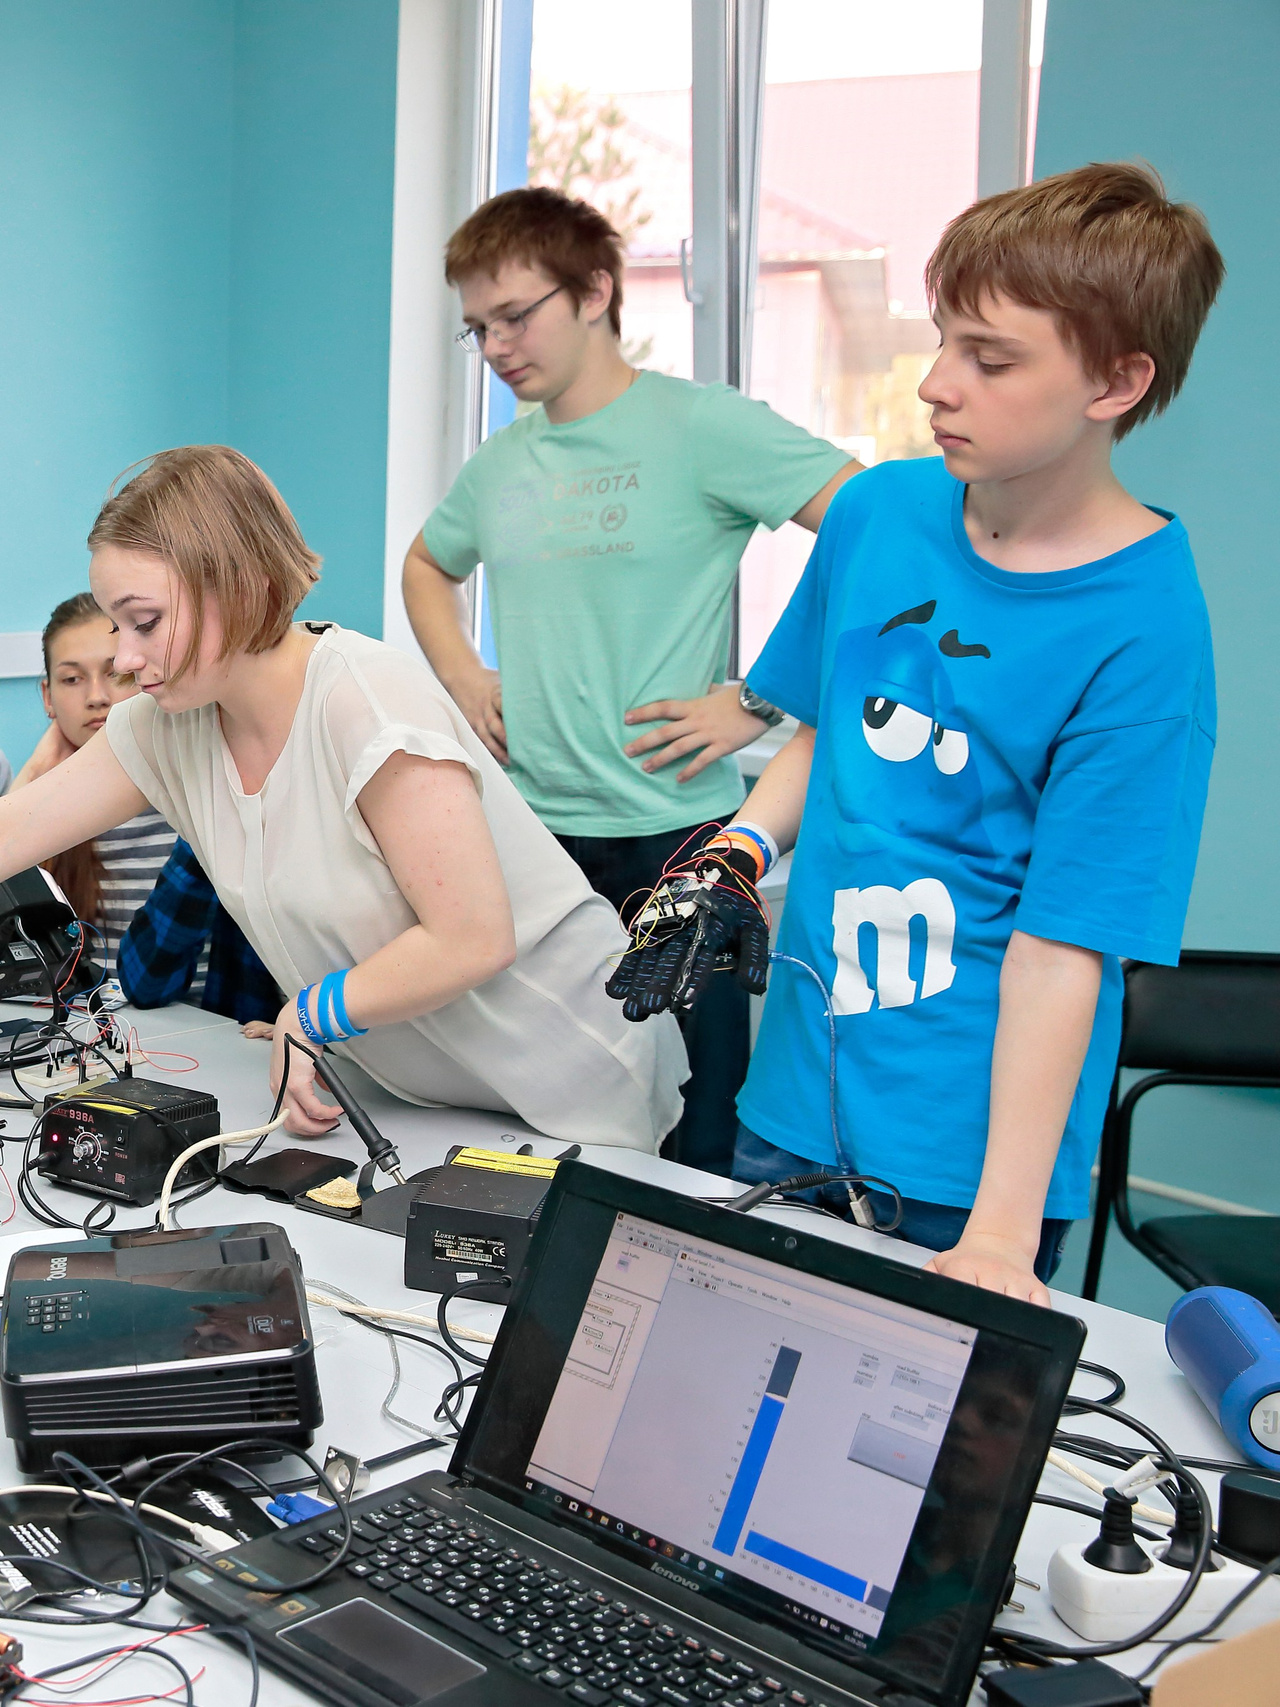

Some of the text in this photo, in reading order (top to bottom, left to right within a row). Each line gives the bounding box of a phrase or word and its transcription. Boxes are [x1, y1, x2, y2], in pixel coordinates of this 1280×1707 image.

[553, 472, 641, 501] DAKOTA
[824, 877, 957, 1016] m
[70, 1109, 94, 1124] 936A
[650, 1562, 700, 1592] lenovo
